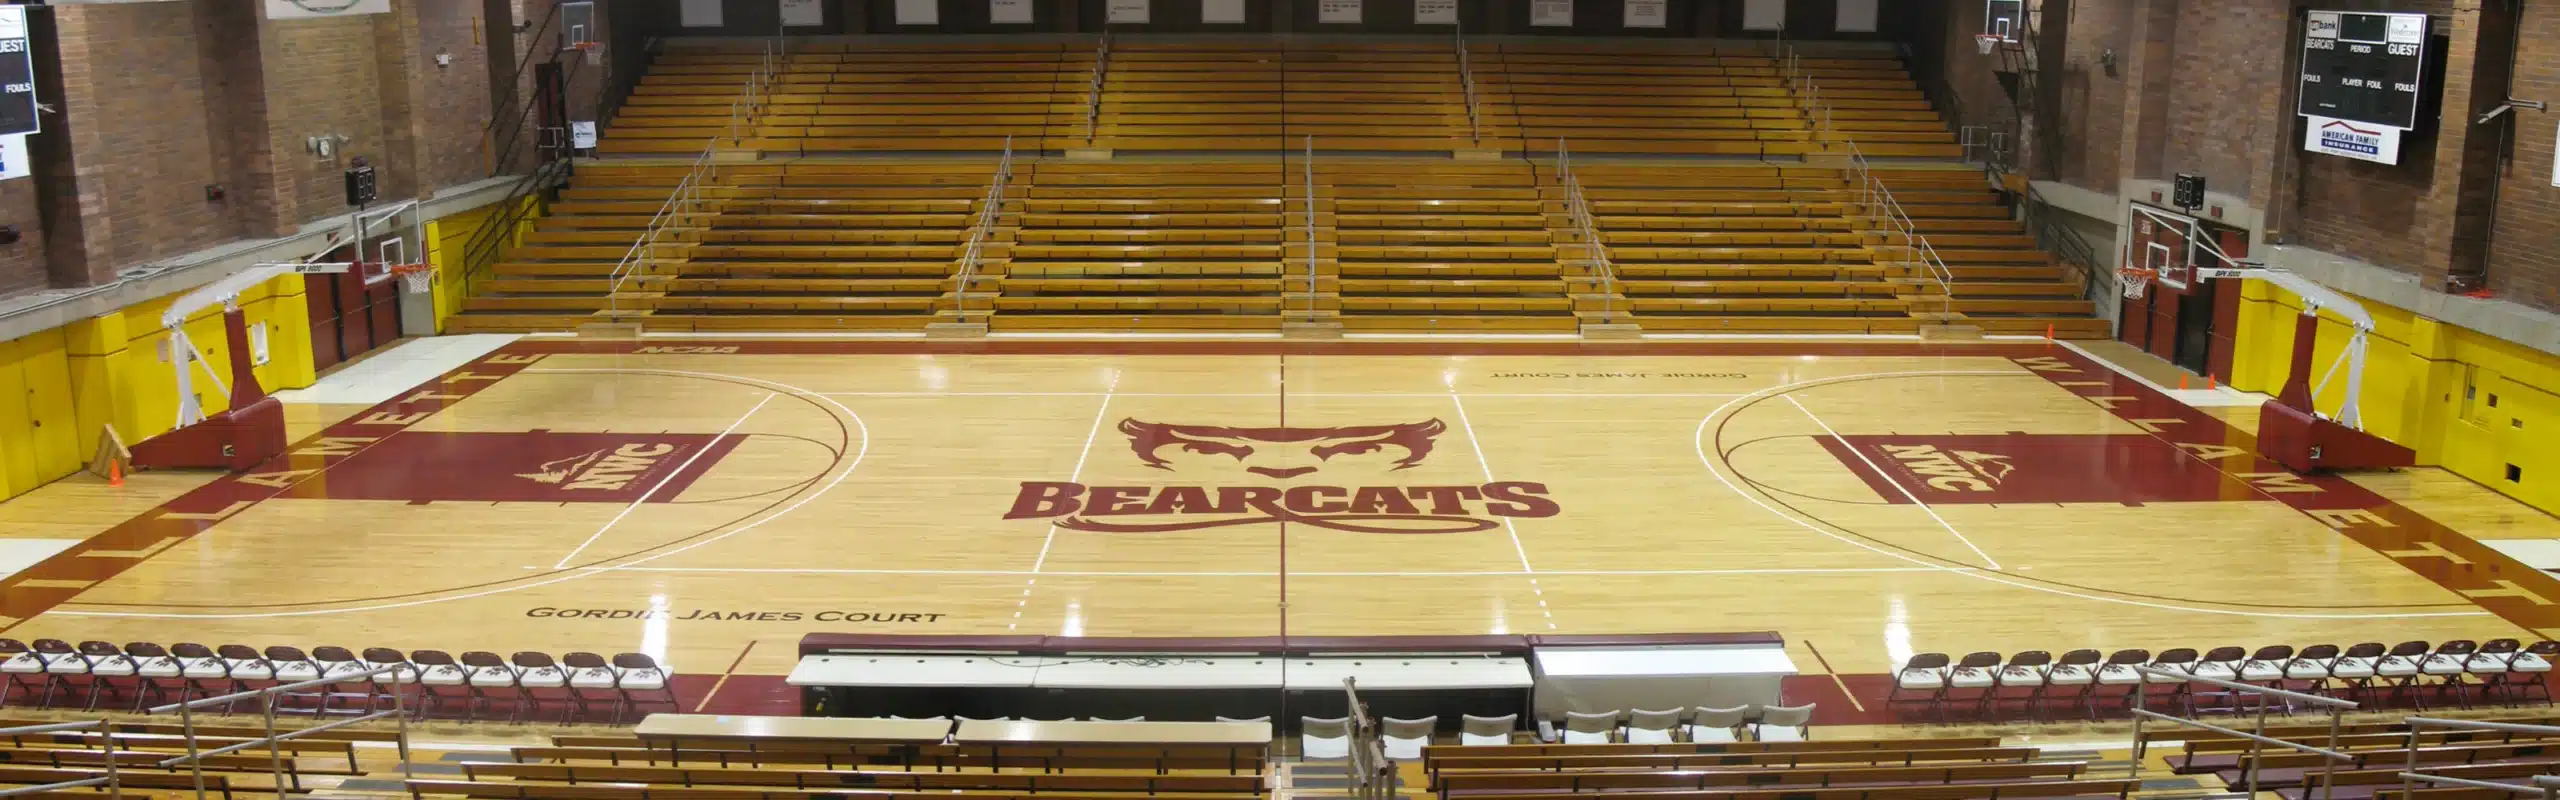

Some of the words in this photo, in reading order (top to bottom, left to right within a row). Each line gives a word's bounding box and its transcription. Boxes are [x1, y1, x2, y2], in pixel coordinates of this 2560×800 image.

[2306, 39, 2335, 50] BEARCATS
[2350, 45, 2371, 54] PERIOD
[2388, 43, 2419, 56] GUEST
[2303, 74, 2321, 83] FOULS
[2342, 78, 2362, 87] PLAYER
[2367, 80, 2382, 89] FOUL
[5, 82, 32, 93] FOULS
[2394, 83, 2415, 92] FOULS
[2322, 130, 2354, 141] AMERICAN
[2355, 134, 2380, 146] FAMILY
[2324, 140, 2375, 152] INSURANCE
[632, 346, 740, 354] NCAA
[561, 443, 674, 490] NWC
[1879, 444, 1996, 492] NWC
[0, 353, 549, 630] ILLAMETTE
[1002, 481, 1561, 520] BEARCATS
[2012, 356, 2560, 643] WILLAMETT
[526, 607, 671, 620] GORDI
